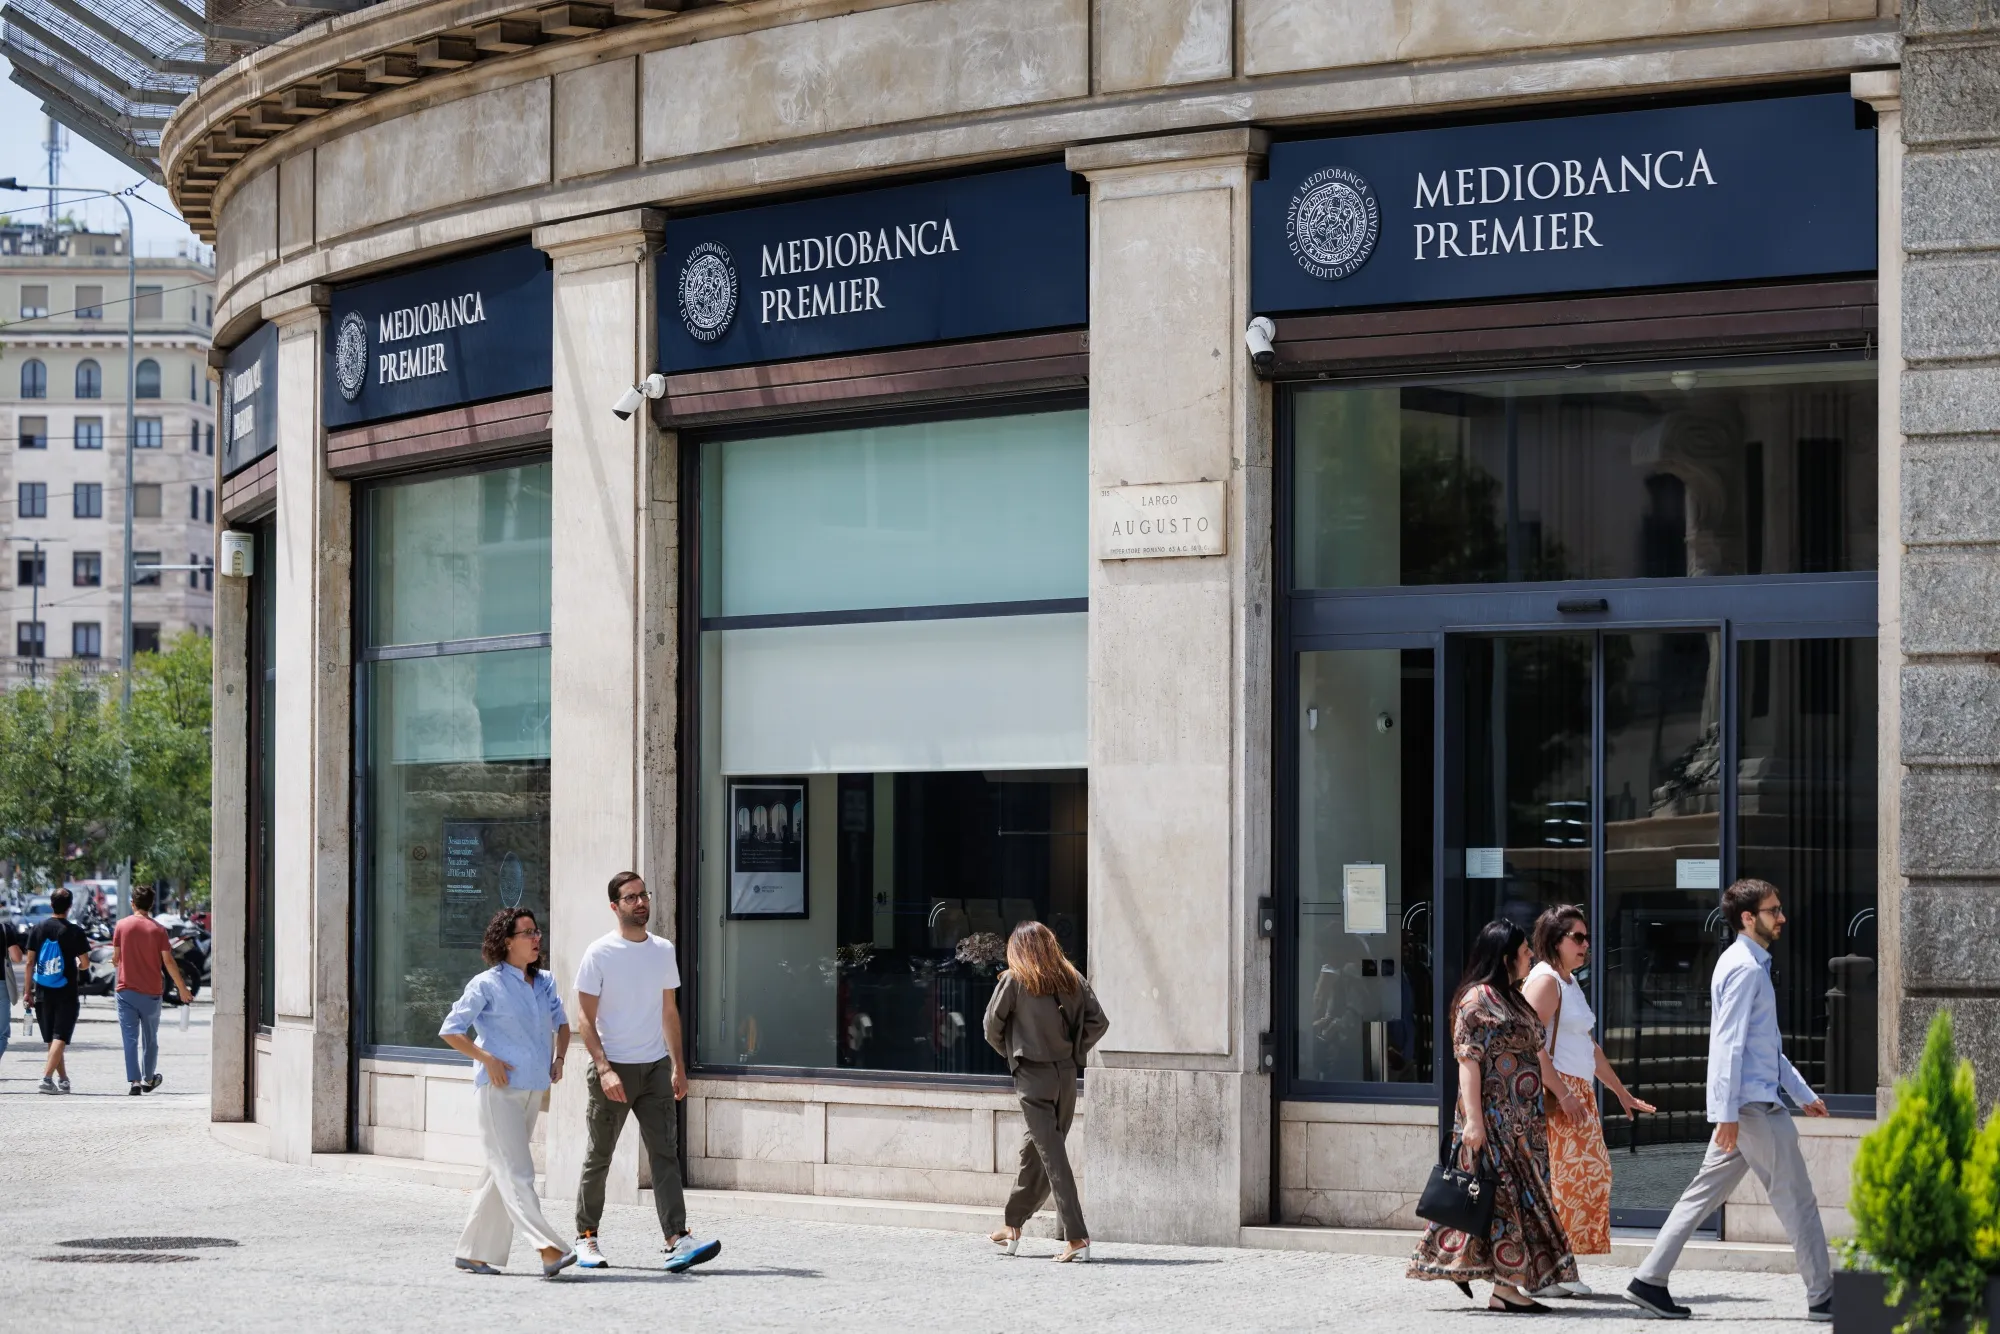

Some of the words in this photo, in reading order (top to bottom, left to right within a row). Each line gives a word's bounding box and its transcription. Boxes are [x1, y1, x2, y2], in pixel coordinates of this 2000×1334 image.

[1300, 168, 1367, 195] MEDIOBANCA
[1413, 149, 1717, 209] MEDIOBANCA
[1286, 196, 1301, 239] BANCA
[1345, 197, 1377, 273] FINANZIARIO
[1413, 211, 1603, 261] PREMIER
[686, 242, 730, 266] MEDIOBANCA
[761, 219, 960, 277] MEDIOBANCA
[1289, 241, 1300, 256] DI
[1298, 255, 1343, 279] CREDITO
[678, 267, 688, 306] BANCA
[717, 267, 738, 335] FINANZIARIO
[761, 276, 886, 324] PREMIER
[379, 291, 486, 344] MEDIOBANCA
[680, 308, 689, 321] DI
[686, 321, 716, 341] CREDITO
[379, 343, 449, 385] PREMIER
[1141, 495, 1178, 506] LARGO
[1112, 517, 1208, 536] AUGUSTO
